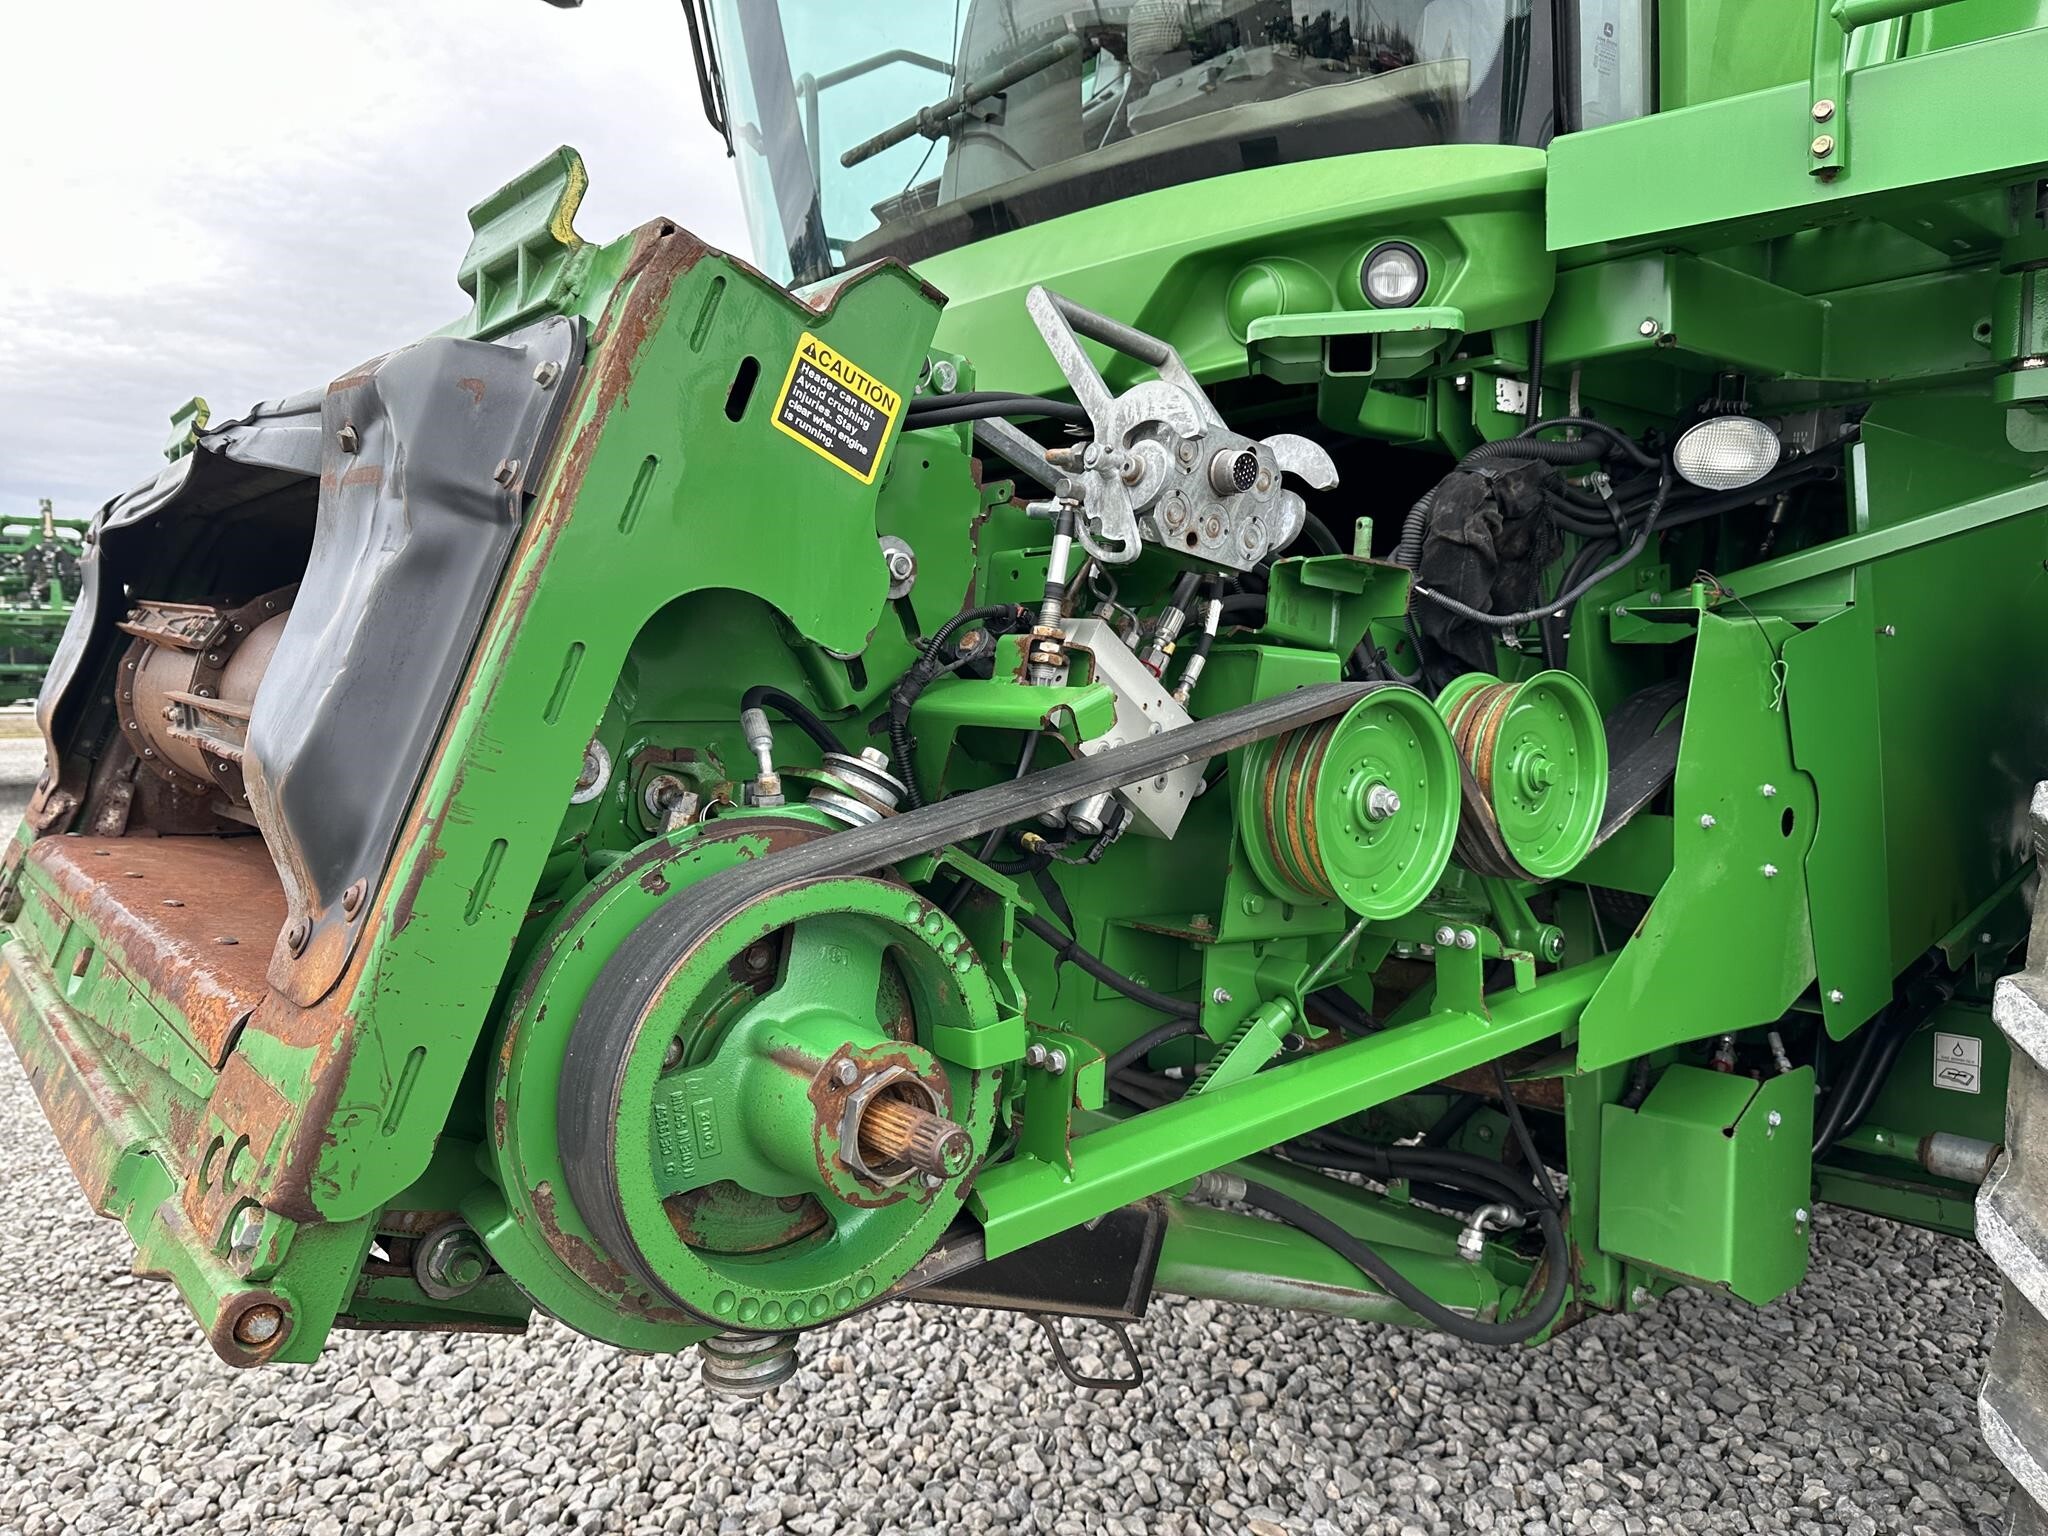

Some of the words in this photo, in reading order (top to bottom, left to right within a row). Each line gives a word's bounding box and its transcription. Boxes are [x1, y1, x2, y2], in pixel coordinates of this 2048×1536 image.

[796, 375, 827, 400] Avoid
[827, 397, 870, 431] crushing
[801, 362, 838, 393] Header
[839, 391, 858, 408] can
[859, 402, 876, 421] tilt.
[818, 350, 895, 412] CAUTION
[784, 408, 794, 422] is
[795, 417, 834, 448] running.
[788, 399, 813, 418] clear
[812, 413, 838, 436] when
[838, 430, 868, 456] engine
[792, 386, 832, 419] injuries.
[835, 414, 858, 436] Stay
